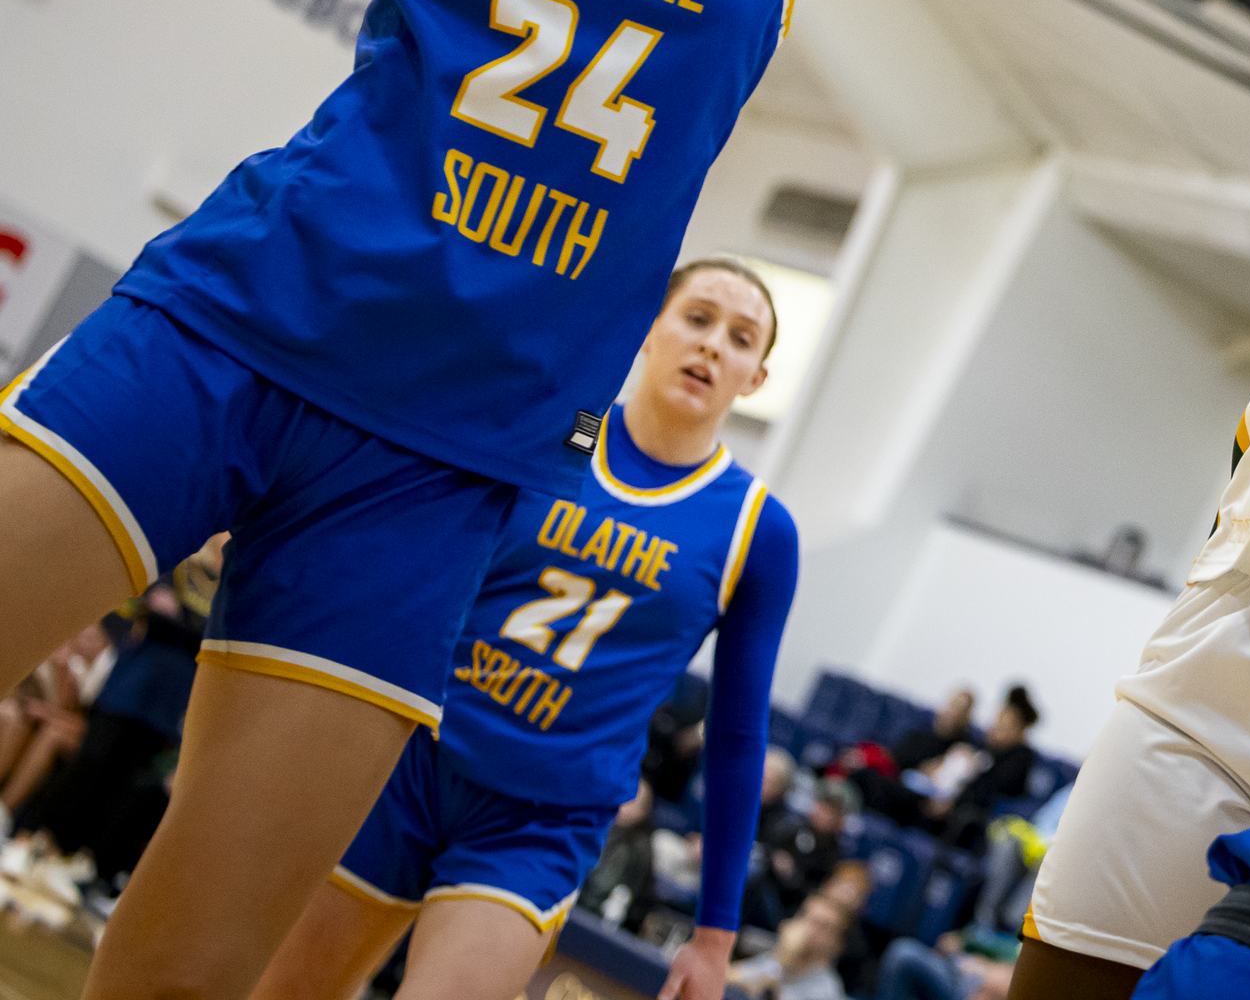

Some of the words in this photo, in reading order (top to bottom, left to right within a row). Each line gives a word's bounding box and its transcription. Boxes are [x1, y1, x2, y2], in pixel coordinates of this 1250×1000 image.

[431, 148, 609, 280] SOUTH
[537, 499, 679, 592] OLATHE
[500, 566, 632, 673] 21
[454, 639, 573, 732] SOUTH
